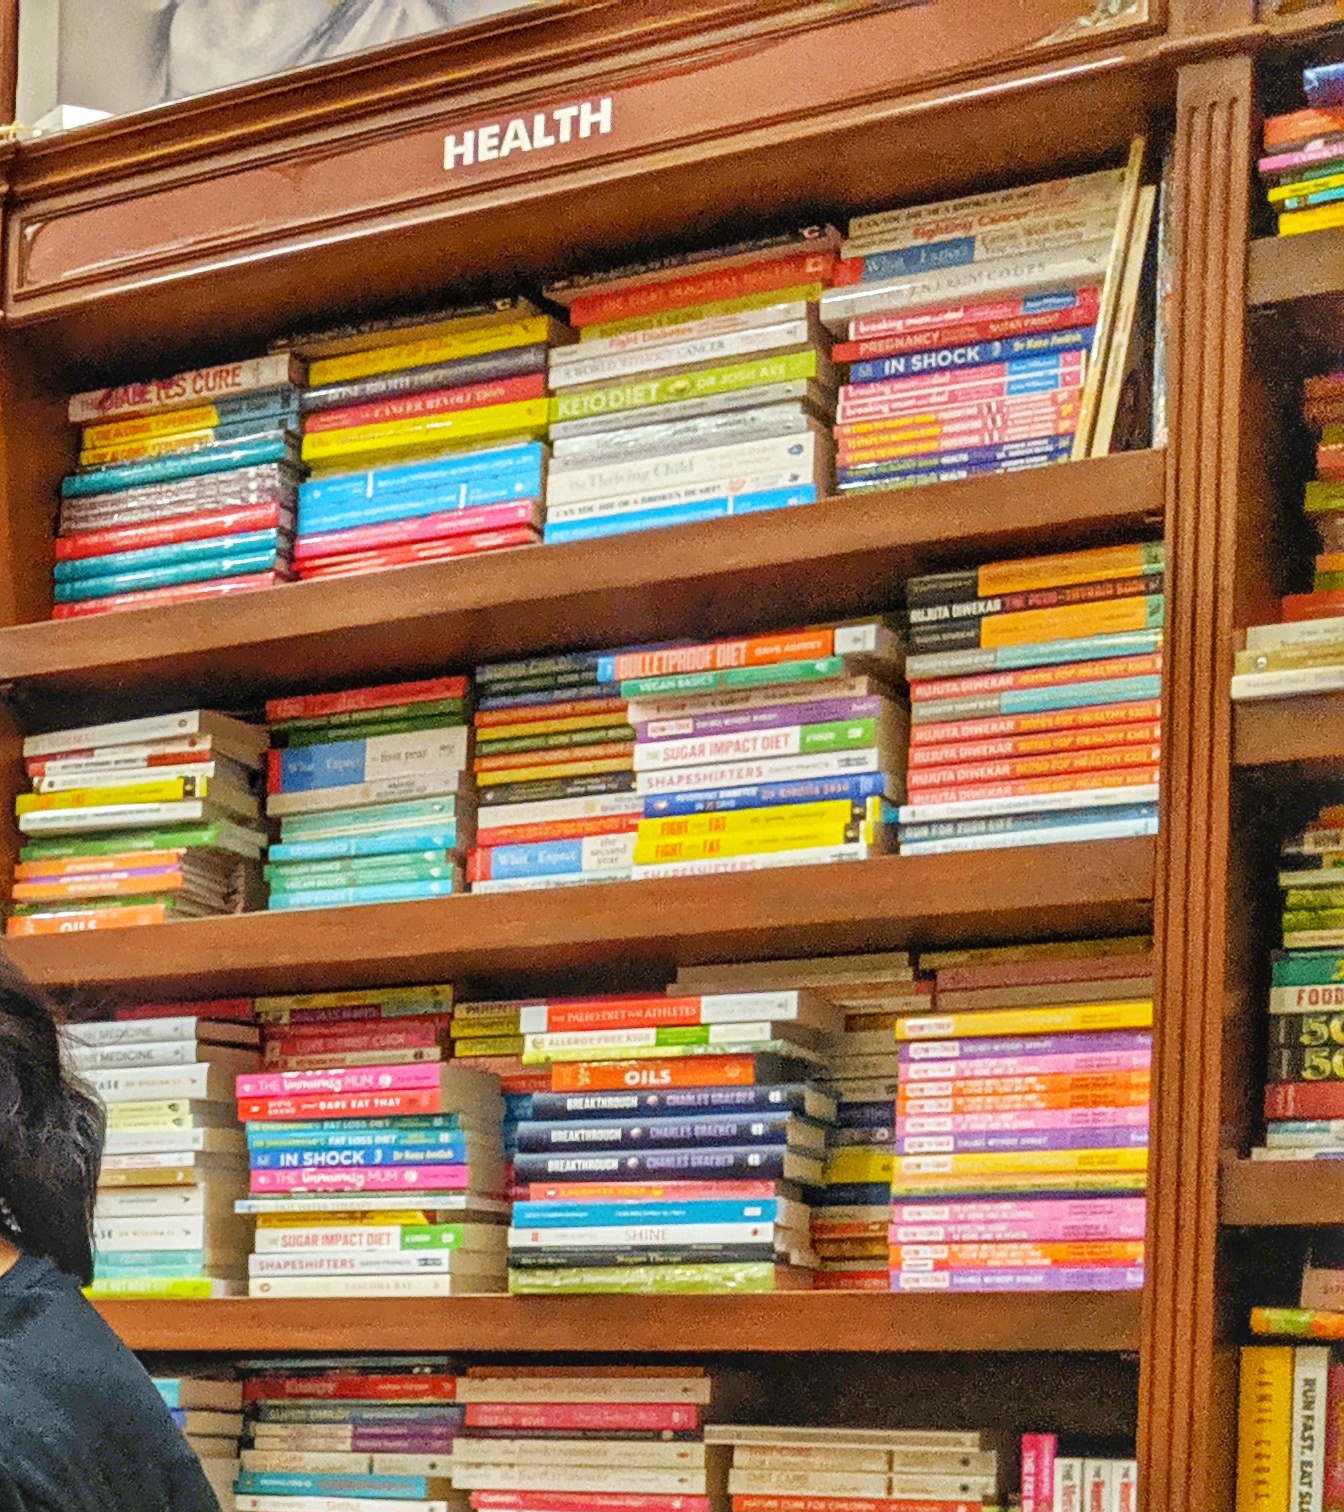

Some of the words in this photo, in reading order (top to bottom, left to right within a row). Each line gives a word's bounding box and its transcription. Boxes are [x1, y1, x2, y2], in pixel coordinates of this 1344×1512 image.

[443, 98, 613, 170] HEALTH
[885, 360, 904, 374] IN
[912, 345, 980, 370] SHOCK
[192, 366, 241, 395] CURE
[558, 382, 660, 418] KETODIET
[588, 467, 649, 489] Thriving
[654, 459, 695, 478] Child
[618, 644, 713, 677] BULLETPROOF
[716, 643, 747, 668] DIET
[916, 680, 959, 697] RUJUTA
[962, 675, 1013, 693] DIWEKAR
[916, 726, 959, 742] RUJUTA
[961, 720, 1015, 737] DIWEKAR
[663, 741, 706, 762] SUGAR
[709, 738, 758, 759] IMPACT
[761, 733, 791, 752] DIET
[914, 748, 956, 764] RUJUTA
[959, 742, 1012, 759] DIWEKAR
[646, 765, 764, 789] SHAPESHIFTERS
[912, 770, 956, 784] RUJUTA
[959, 765, 1010, 782] DIWEKAR
[660, 819, 688, 836] FIGHT
[708, 816, 728, 832] FAT
[654, 842, 683, 859] FIGHT
[702, 839, 721, 855] FAT
[645, 1004, 697, 1019] ATHLETES
[100, 1027, 153, 1041] MEDICINE
[548, 1033, 622, 1047] ALLERGY-FREE
[625, 1031, 652, 1044] KIDS
[100, 1049, 154, 1061] MEDICINE
[259, 1081, 279, 1092] THE
[345, 1075, 373, 1087] MUM
[624, 1069, 672, 1085] OILS
[351, 1100, 370, 1109] EAT
[566, 1096, 638, 1110] BREAKTHROUGH
[666, 1094, 704, 1107] CHARLES
[328, 1137, 345, 1145] FAT
[348, 1136, 372, 1144] LOSS
[375, 1135, 396, 1143] DIET
[550, 1128, 622, 1142] BREAKTHROUGH
[650, 1126, 692, 1139] CHARLES
[279, 1154, 298, 1167] IN
[302, 1151, 364, 1165] SHOCK
[547, 1158, 619, 1172] BREAKTHROUGH
[646, 1155, 689, 1169] CHARLES
[275, 1173, 296, 1184] THE
[367, 1171, 397, 1181] MUM
[281, 1234, 323, 1248] SUGAR
[326, 1233, 367, 1247] IMPACT
[368, 1232, 392, 1246] DIET
[625, 1229, 668, 1241] SHINE
[258, 1257, 356, 1271] SHAPESHIFTERS
[1303, 1378, 1317, 1412] RUN
[1300, 1414, 1315, 1456] FAST.
[1062, 1463, 1073, 1481] THE
[1300, 1460, 1314, 1487] EAT
